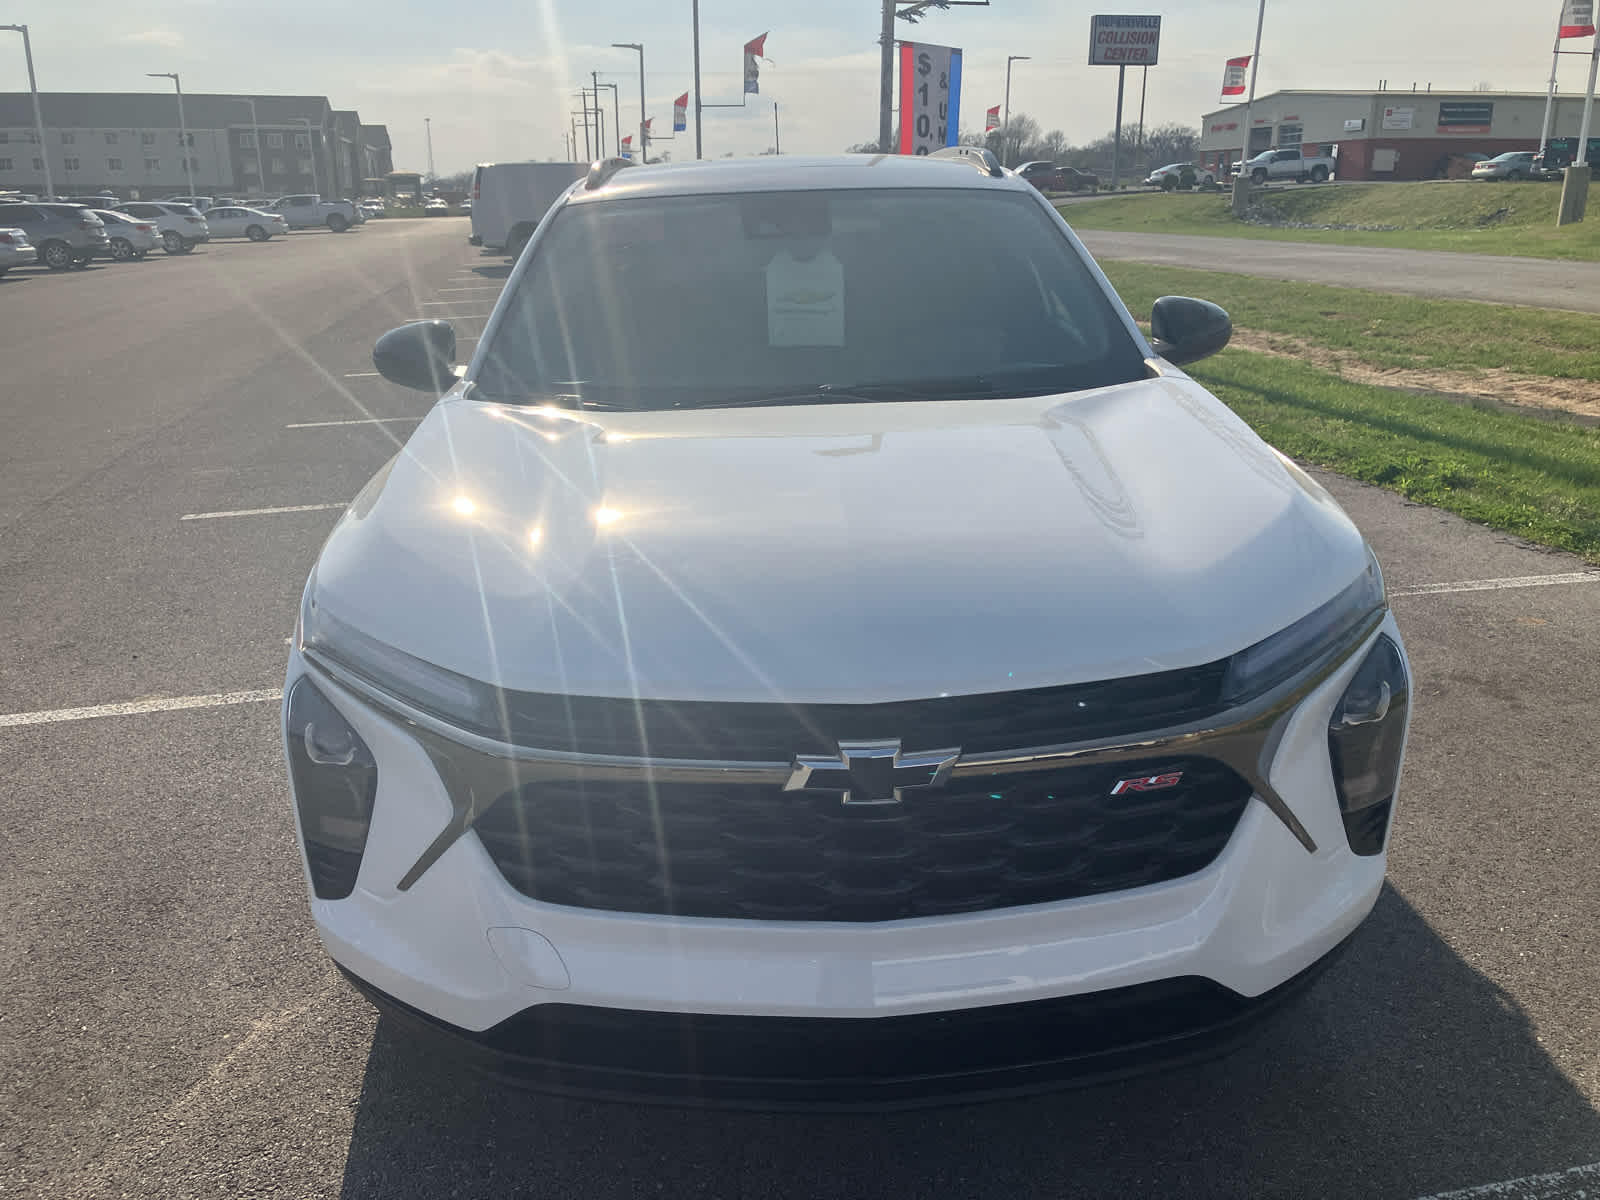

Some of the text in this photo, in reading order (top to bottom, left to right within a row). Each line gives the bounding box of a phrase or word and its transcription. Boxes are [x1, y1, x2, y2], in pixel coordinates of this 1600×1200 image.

[1097, 31, 1157, 45] COLLISION
[1103, 47, 1149, 60] CENTER
[1110, 771, 1184, 794] RS
